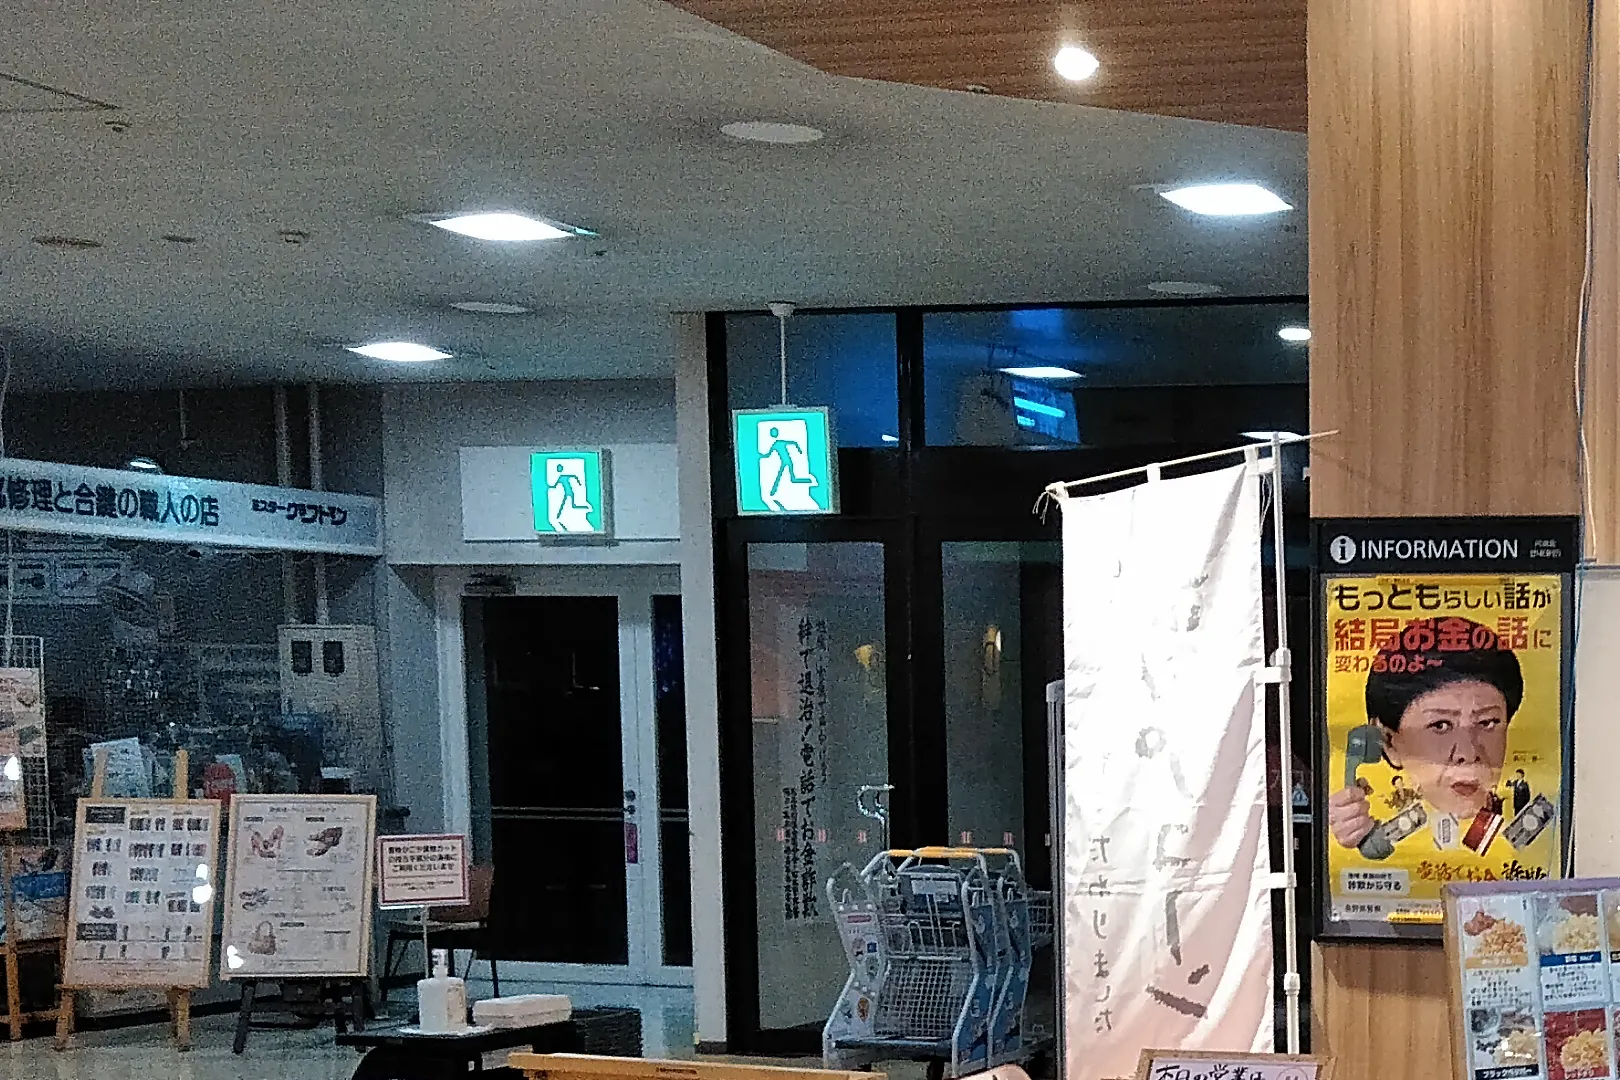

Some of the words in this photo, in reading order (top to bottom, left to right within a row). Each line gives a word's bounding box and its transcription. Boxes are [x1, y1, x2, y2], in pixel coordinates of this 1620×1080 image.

[1361, 539, 1519, 560] INFORMATION
[1335, 582, 1552, 611] もっともらしい話が
[1334, 616, 1552, 652] 結局お金の話に
